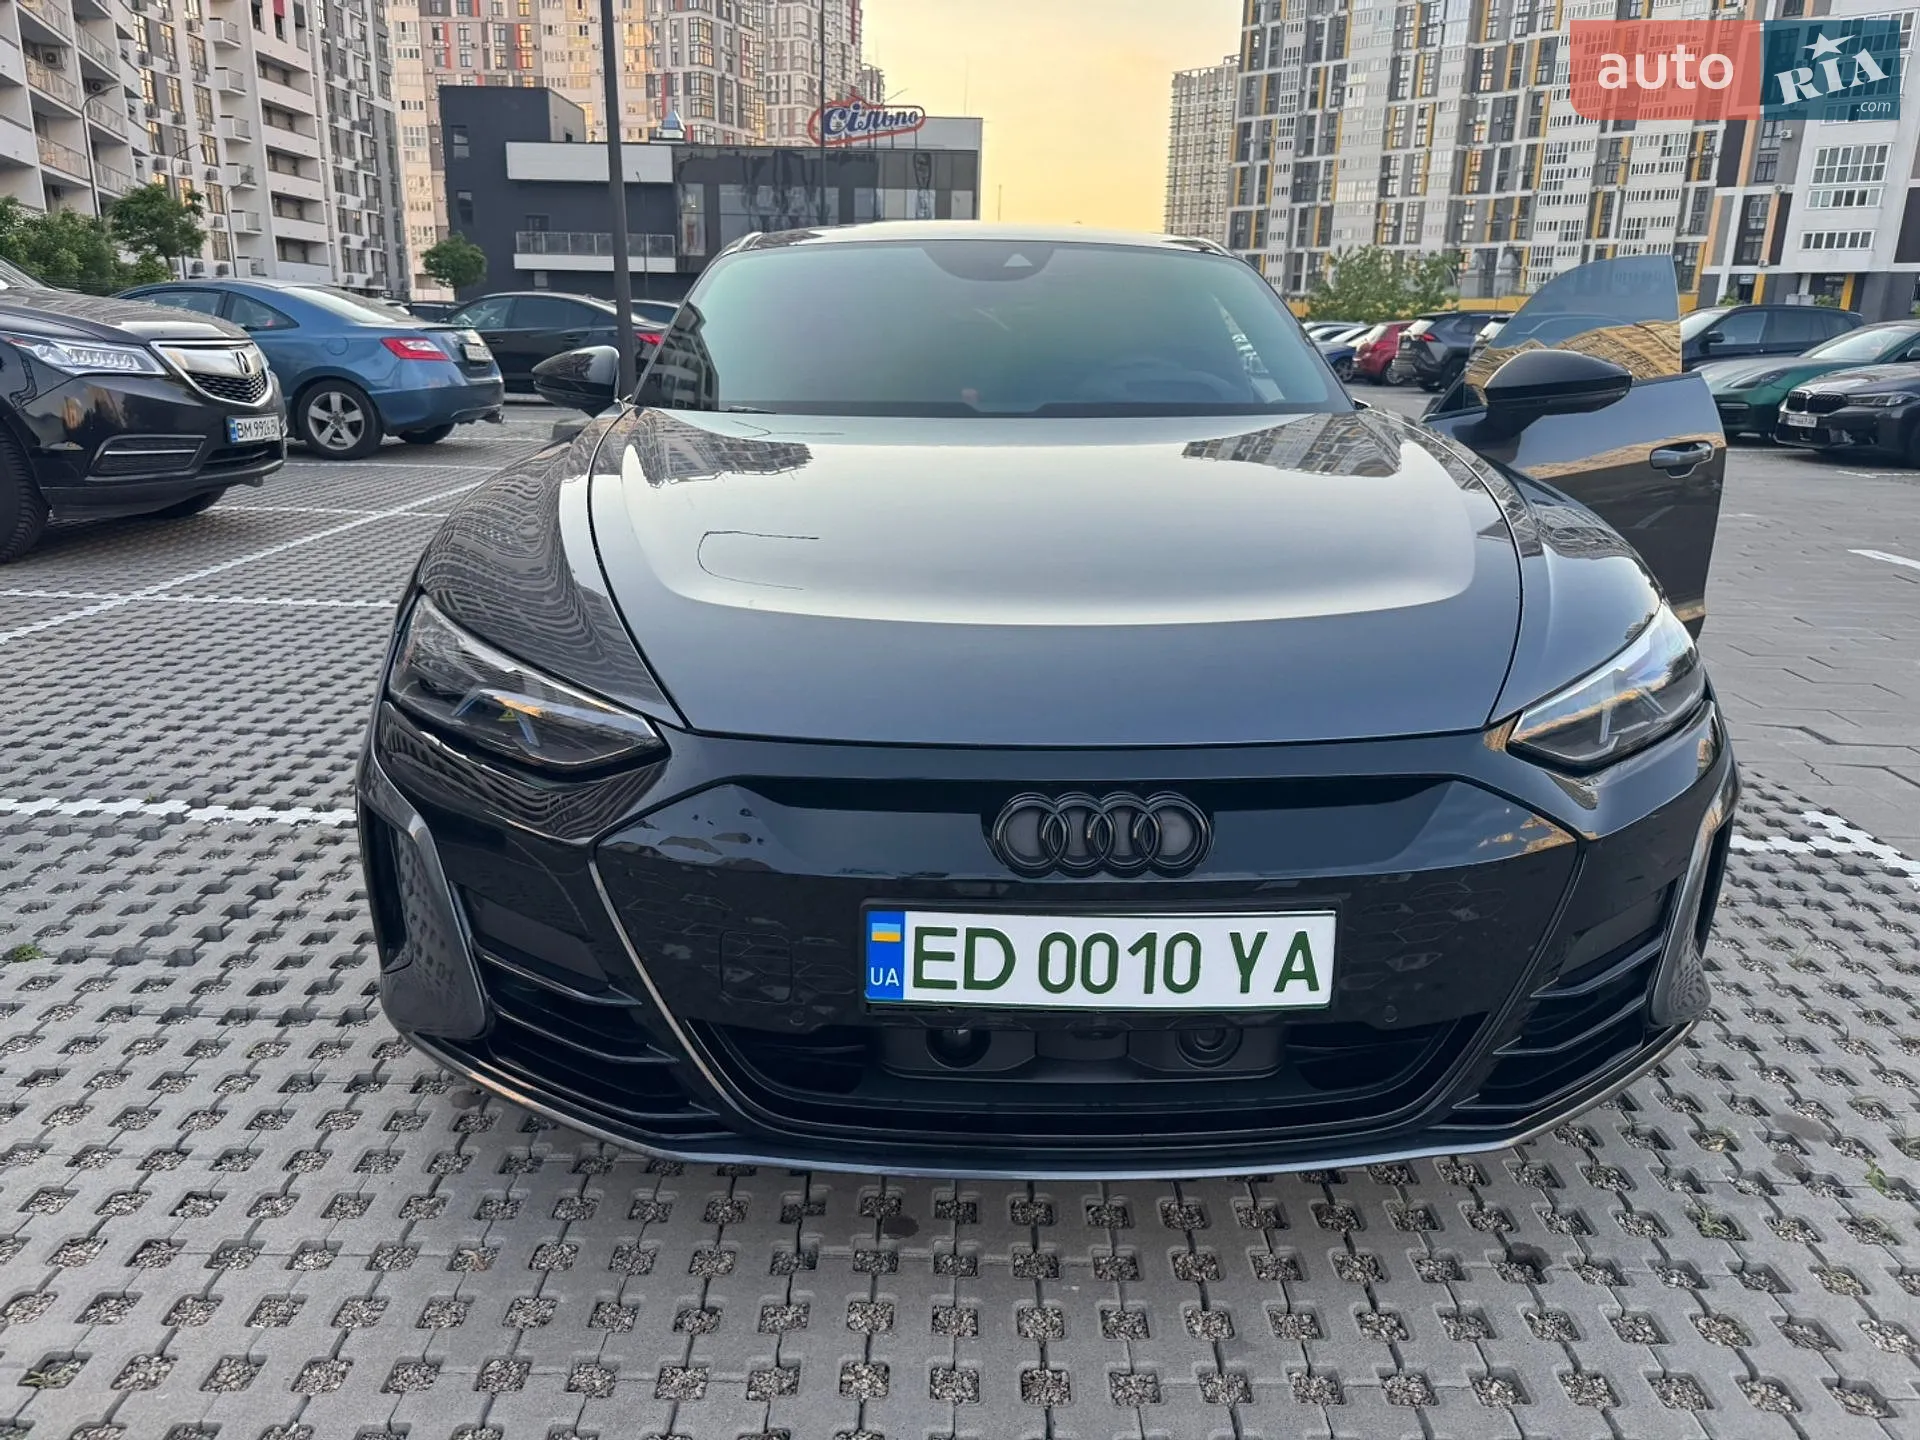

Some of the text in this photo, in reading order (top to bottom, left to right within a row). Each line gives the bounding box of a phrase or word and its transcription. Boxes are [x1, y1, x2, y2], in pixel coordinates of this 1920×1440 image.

[822, 101, 919, 135] Сільпо
[870, 967, 900, 986] UA
[913, 926, 1320, 994] ED 0010 YA
